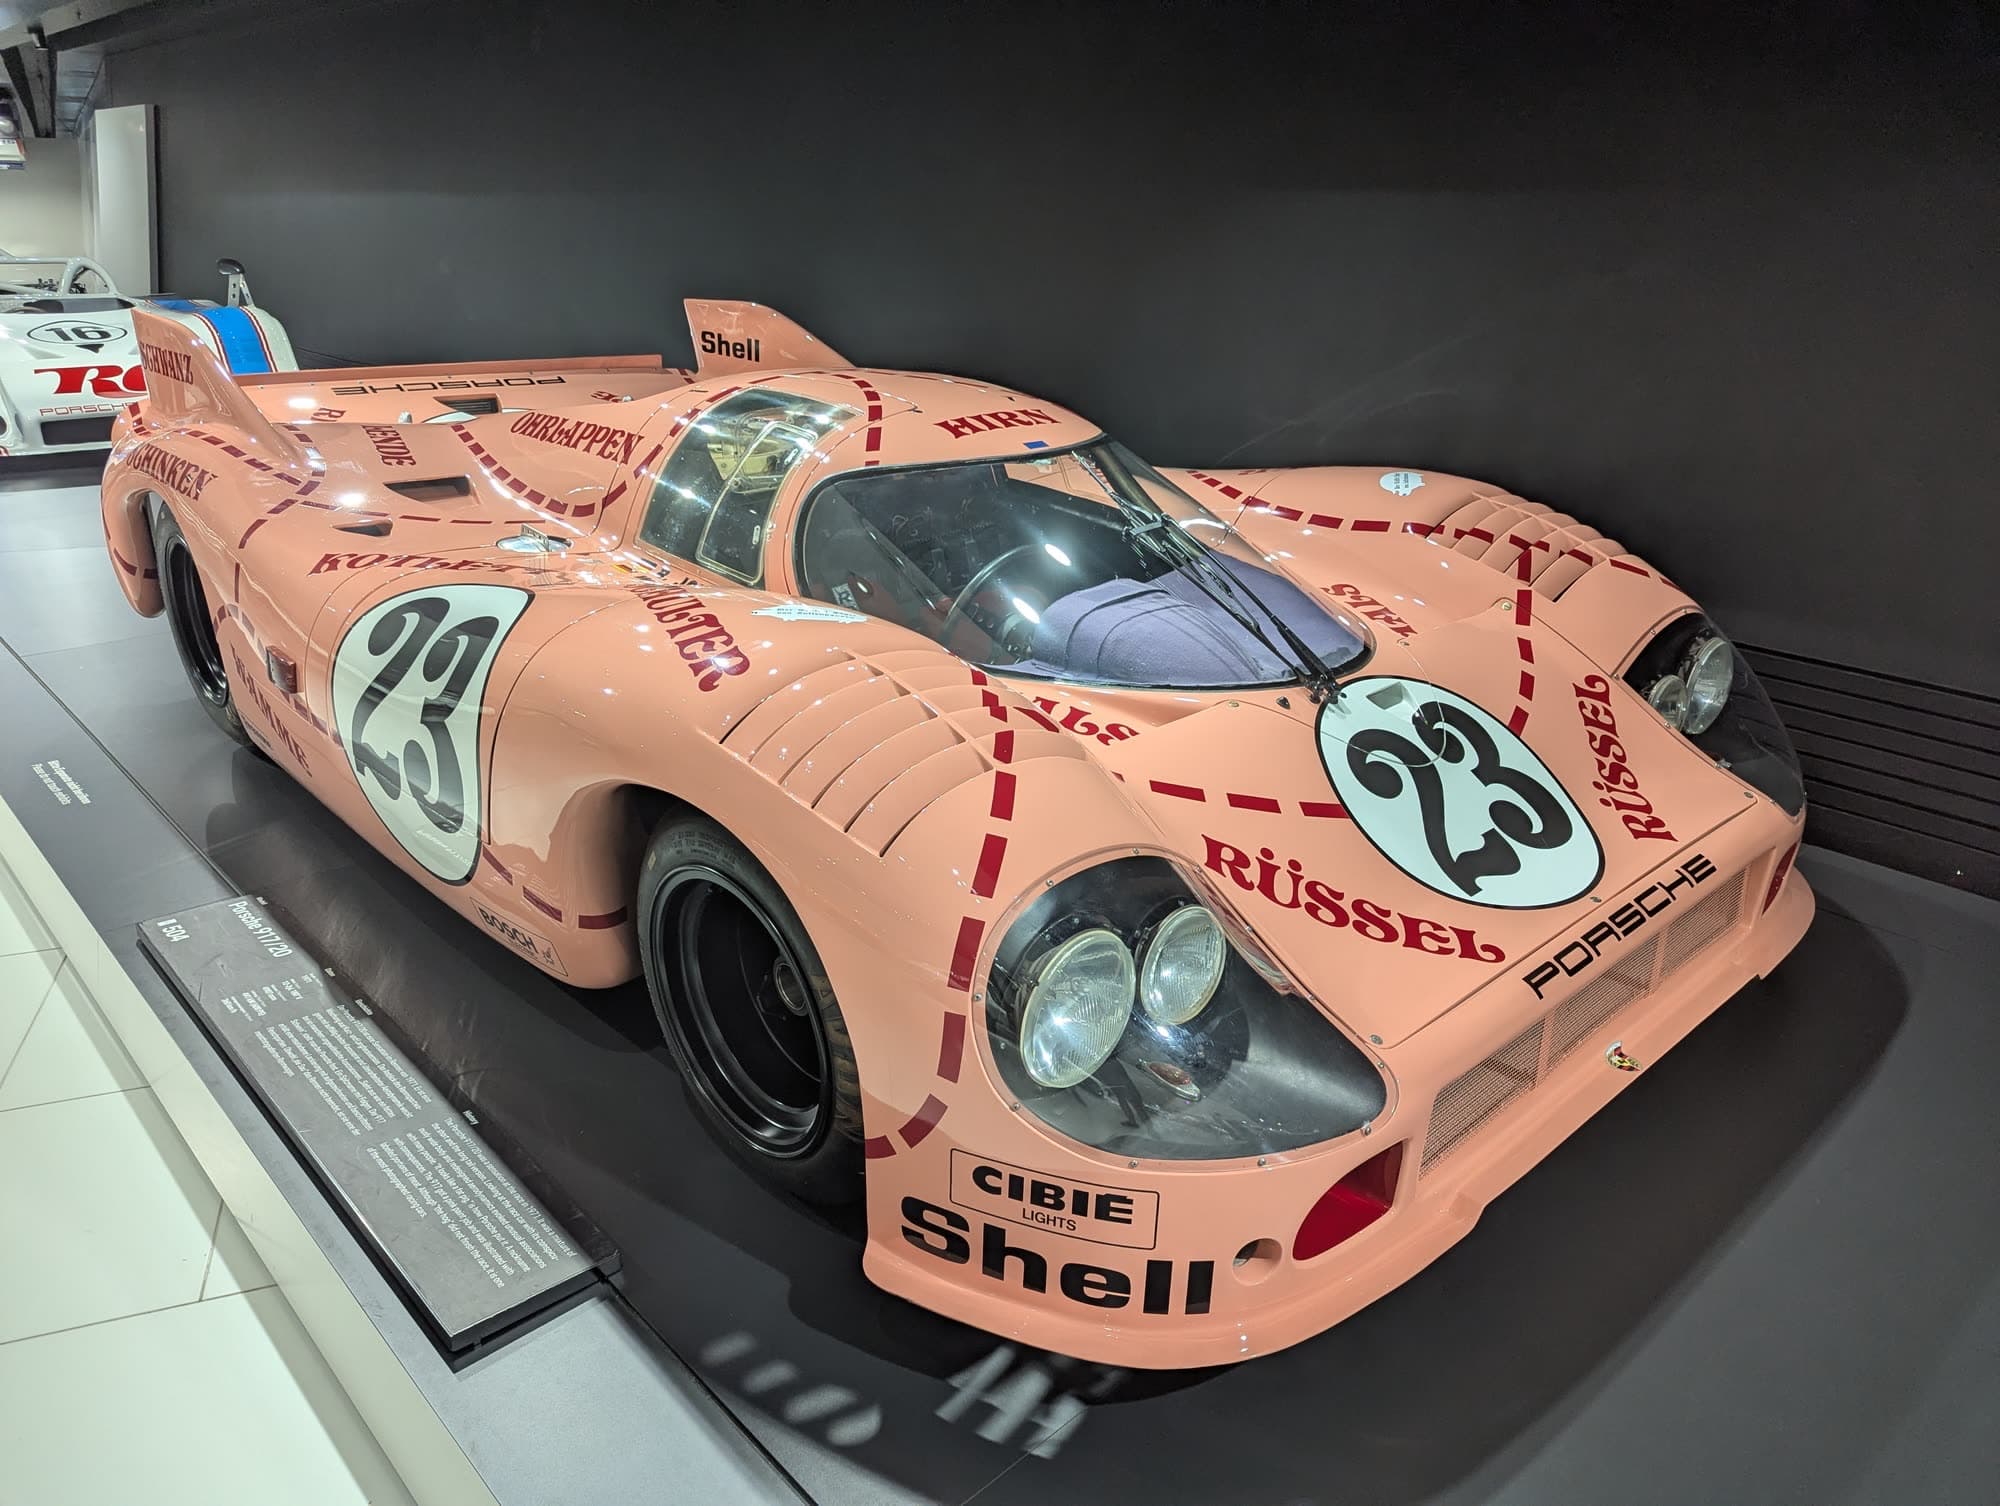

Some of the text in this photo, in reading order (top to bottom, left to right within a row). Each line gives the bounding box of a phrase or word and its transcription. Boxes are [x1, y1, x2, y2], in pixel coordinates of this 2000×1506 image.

[45, 326, 111, 341] 16
[701, 331, 760, 362] Shell
[40, 402, 130, 416] PORSCH
[331, 376, 567, 395] PORSCHE
[510, 412, 645, 465] OHRLAPPEN
[933, 409, 1062, 439] HIRN
[351, 597, 500, 834] 23
[1571, 673, 1679, 843] RÜSSEL
[1346, 700, 1574, 898] 23
[1201, 834, 1506, 964] RÜSSEL
[162, 923, 190, 942] 504
[228, 900, 293, 958] Porsche 917/20
[478, 907, 539, 954] BOSCH
[1521, 853, 1718, 1000] PORSCHE
[1022, 1207, 1077, 1232] LIGHTS
[901, 1196, 1215, 1315] Shell
